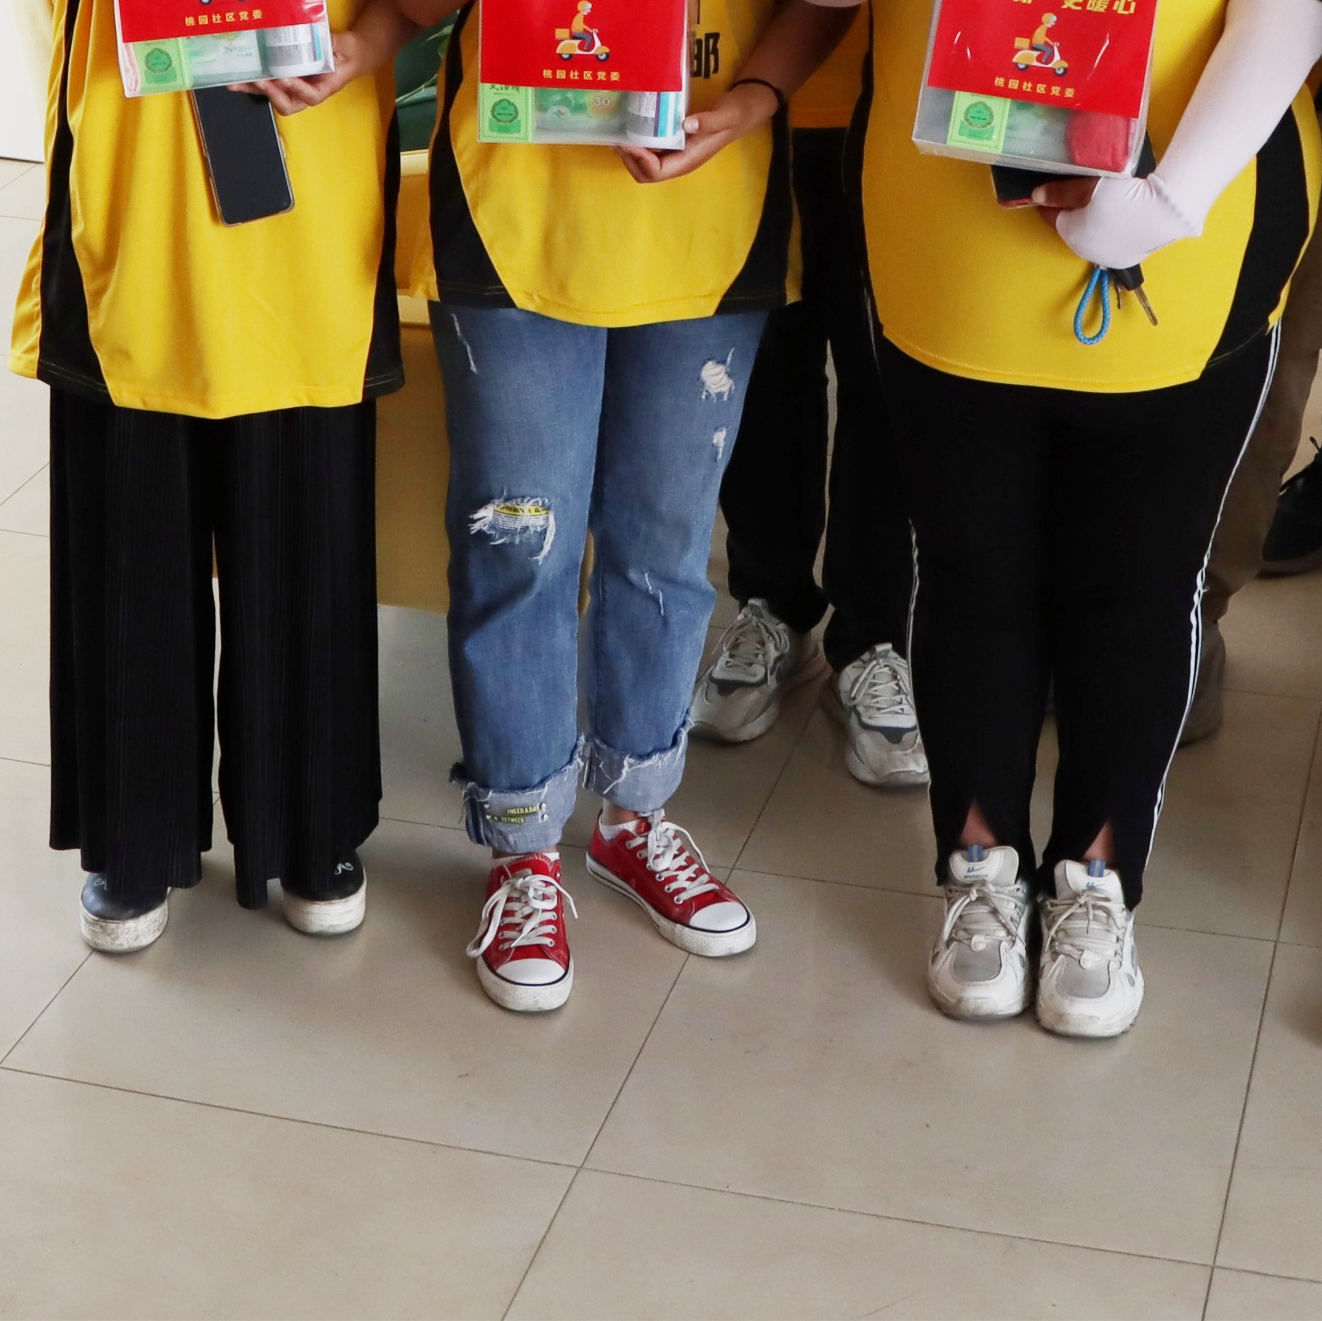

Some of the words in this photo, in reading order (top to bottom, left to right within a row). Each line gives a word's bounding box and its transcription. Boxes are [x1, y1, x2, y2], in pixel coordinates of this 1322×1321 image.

[185, 9, 263, 26] 桃园社区党委
[542, 69, 620, 82] 桃园社区党委
[994, 76, 1076, 99] 桃园社区党委
